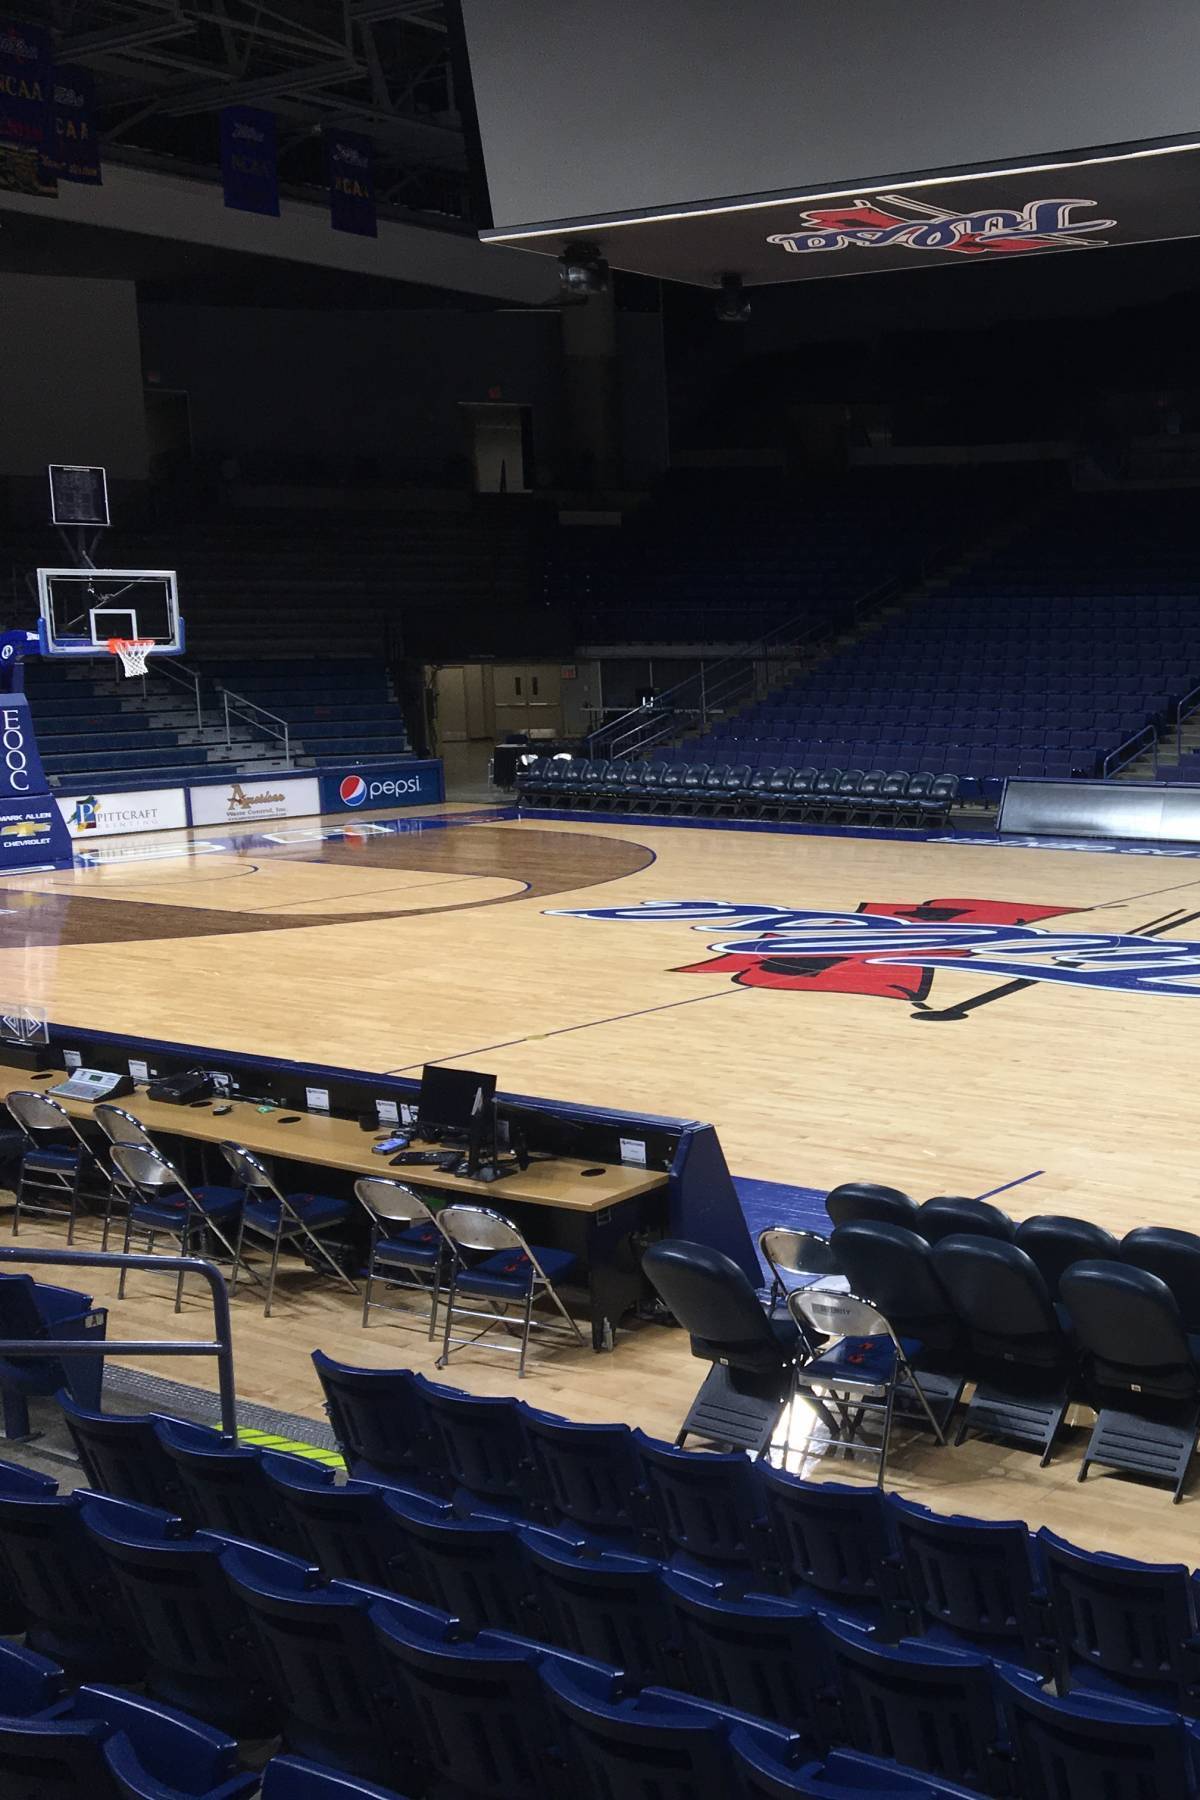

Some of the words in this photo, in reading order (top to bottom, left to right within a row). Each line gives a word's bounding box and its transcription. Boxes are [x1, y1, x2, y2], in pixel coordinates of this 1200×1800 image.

[3, 709, 29, 791] EOOC
[369, 775, 421, 799] pepsi
[25, 812, 52, 820] ALLEN
[97, 808, 158, 823] PITTCRAFT
[3, 838, 51, 848] CHEVROLET
